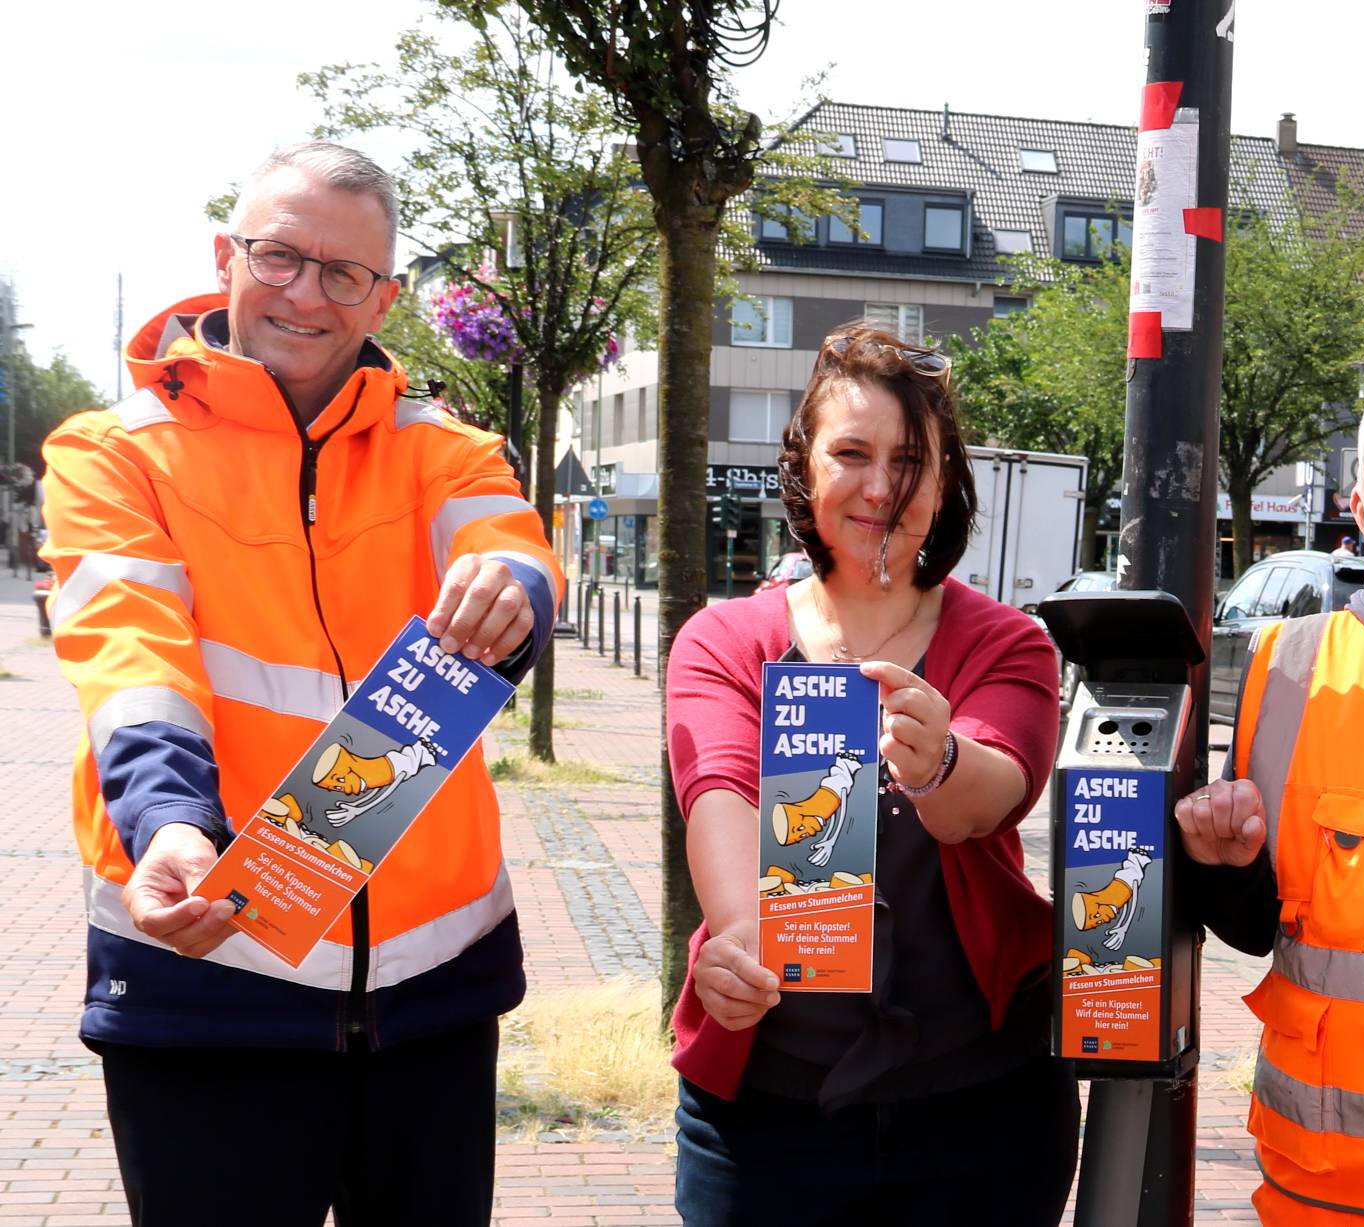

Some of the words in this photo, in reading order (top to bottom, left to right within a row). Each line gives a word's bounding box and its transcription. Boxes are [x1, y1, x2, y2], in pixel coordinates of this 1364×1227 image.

[1267, 502, 1298, 513] Haus
[387, 658, 426, 691] ZU
[406, 637, 479, 694] ASCHE
[775, 676, 847, 699] ASCHE
[775, 705, 805, 726] ZU
[1074, 777, 1138, 799] ASCHE
[1074, 804, 1101, 823] ZU
[257, 828, 286, 848] #Essen
[285, 841, 296, 852] vs
[294, 845, 353, 882] Stummelchen
[243, 857, 264, 874] Wirf
[260, 872, 284, 891] deine
[283, 886, 321, 916] Stummel
[258, 852, 274, 866] Sei
[271, 863, 285, 876] ein
[284, 871, 322, 901] Kippster!
[255, 881, 272, 898] hier
[271, 896, 292, 912] rein!
[769, 900, 797, 912] #Essen
[798, 900, 807, 908] vs
[808, 892, 863, 907] Stummelchen
[784, 922, 797, 931] Sei
[799, 922, 812, 931] ein
[814, 922, 850, 933] Kippster!
[777, 933, 796, 942] Wirf
[796, 933, 820, 943] deine
[820, 933, 857, 943] Stummel
[798, 945, 815, 954] hier
[816, 946, 835, 954] rein!
[1069, 981, 1093, 990] #Essen
[1103, 975, 1154, 987] Stummelchen
[1076, 1009, 1092, 1017] Wirf
[1093, 1010, 1114, 1018] deine
[1115, 1011, 1149, 1020] Stummel
[1082, 999, 1094, 1007] Sei
[1095, 1000, 1107, 1008] ein
[1109, 1000, 1142, 1010] Kippster!
[1095, 1020, 1110, 1029] hier
[1111, 1021, 1129, 1030] rein!
